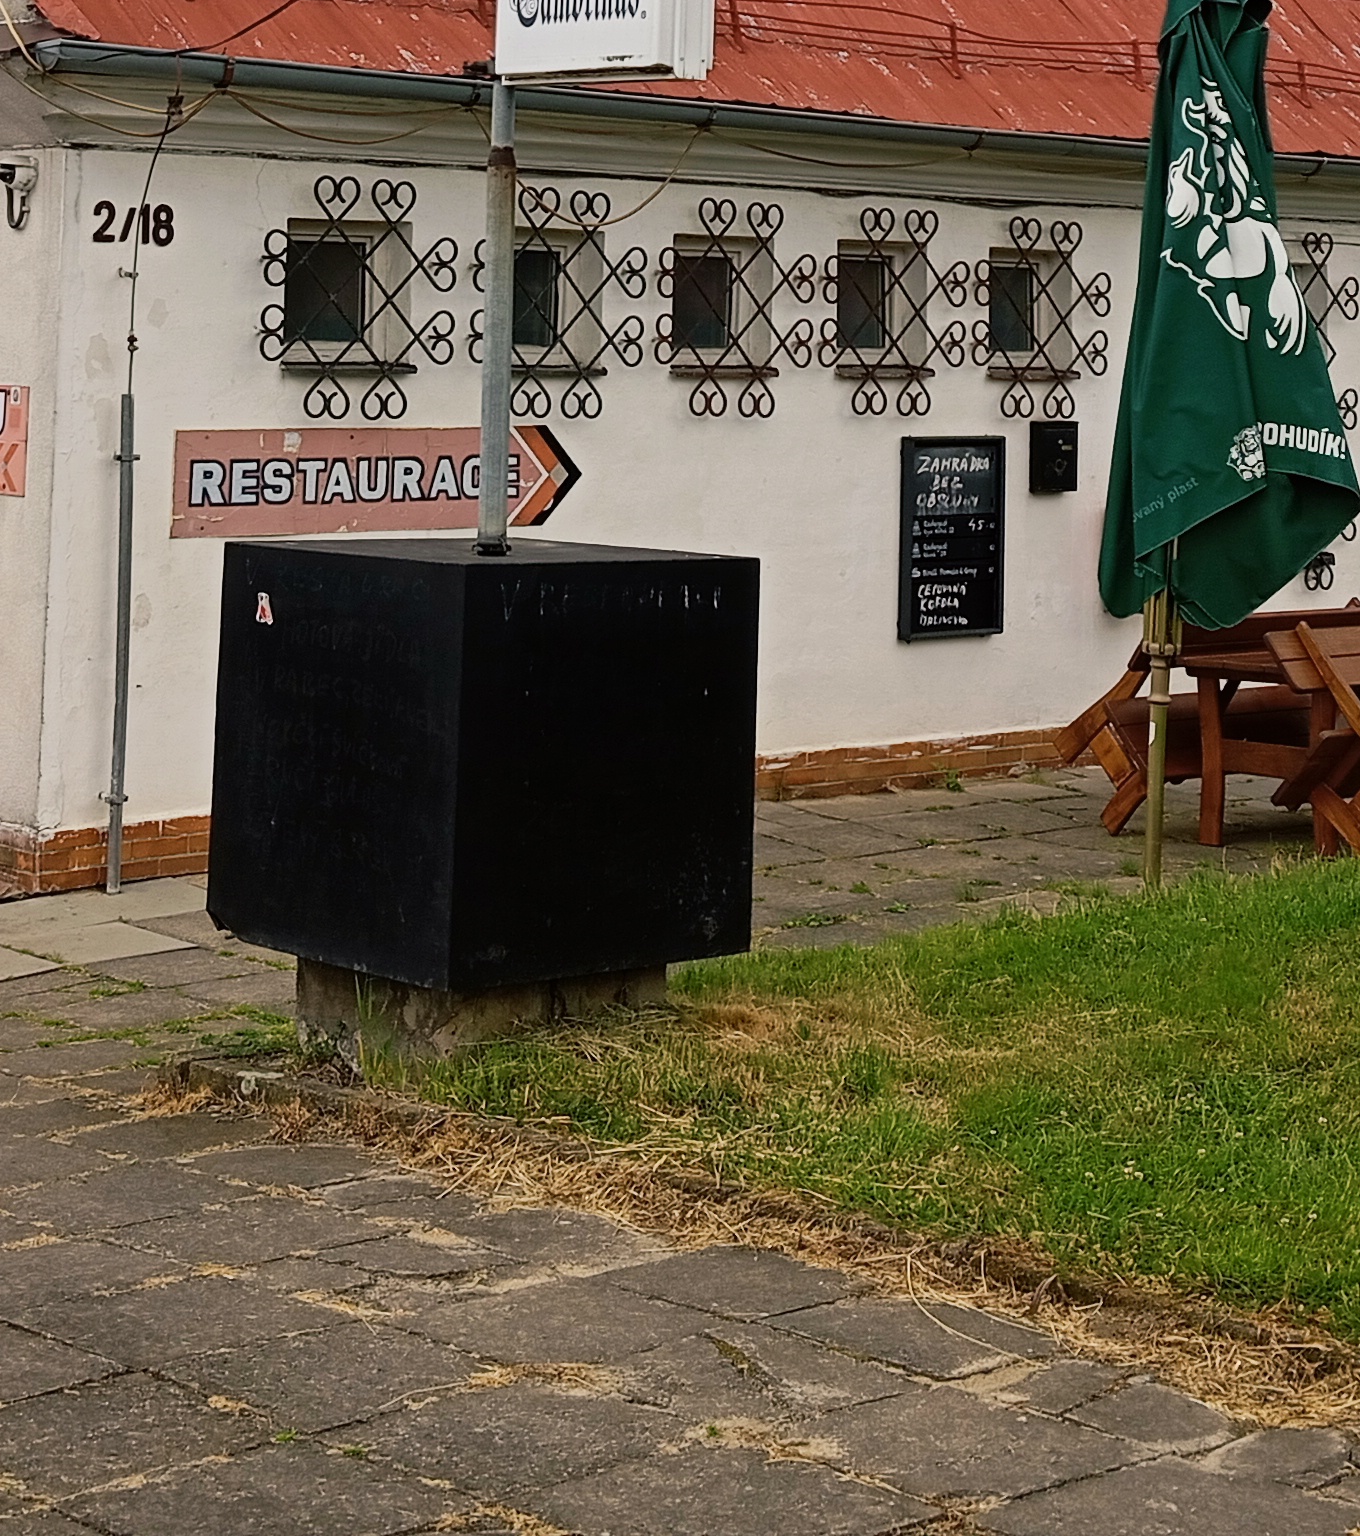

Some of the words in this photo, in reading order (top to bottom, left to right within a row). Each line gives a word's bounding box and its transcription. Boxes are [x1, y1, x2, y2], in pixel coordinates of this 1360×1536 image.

[93, 200, 175, 247] 2/18
[1257, 422, 1346, 459] OHUDÍK!
[1167, 476, 1199, 501] plast
